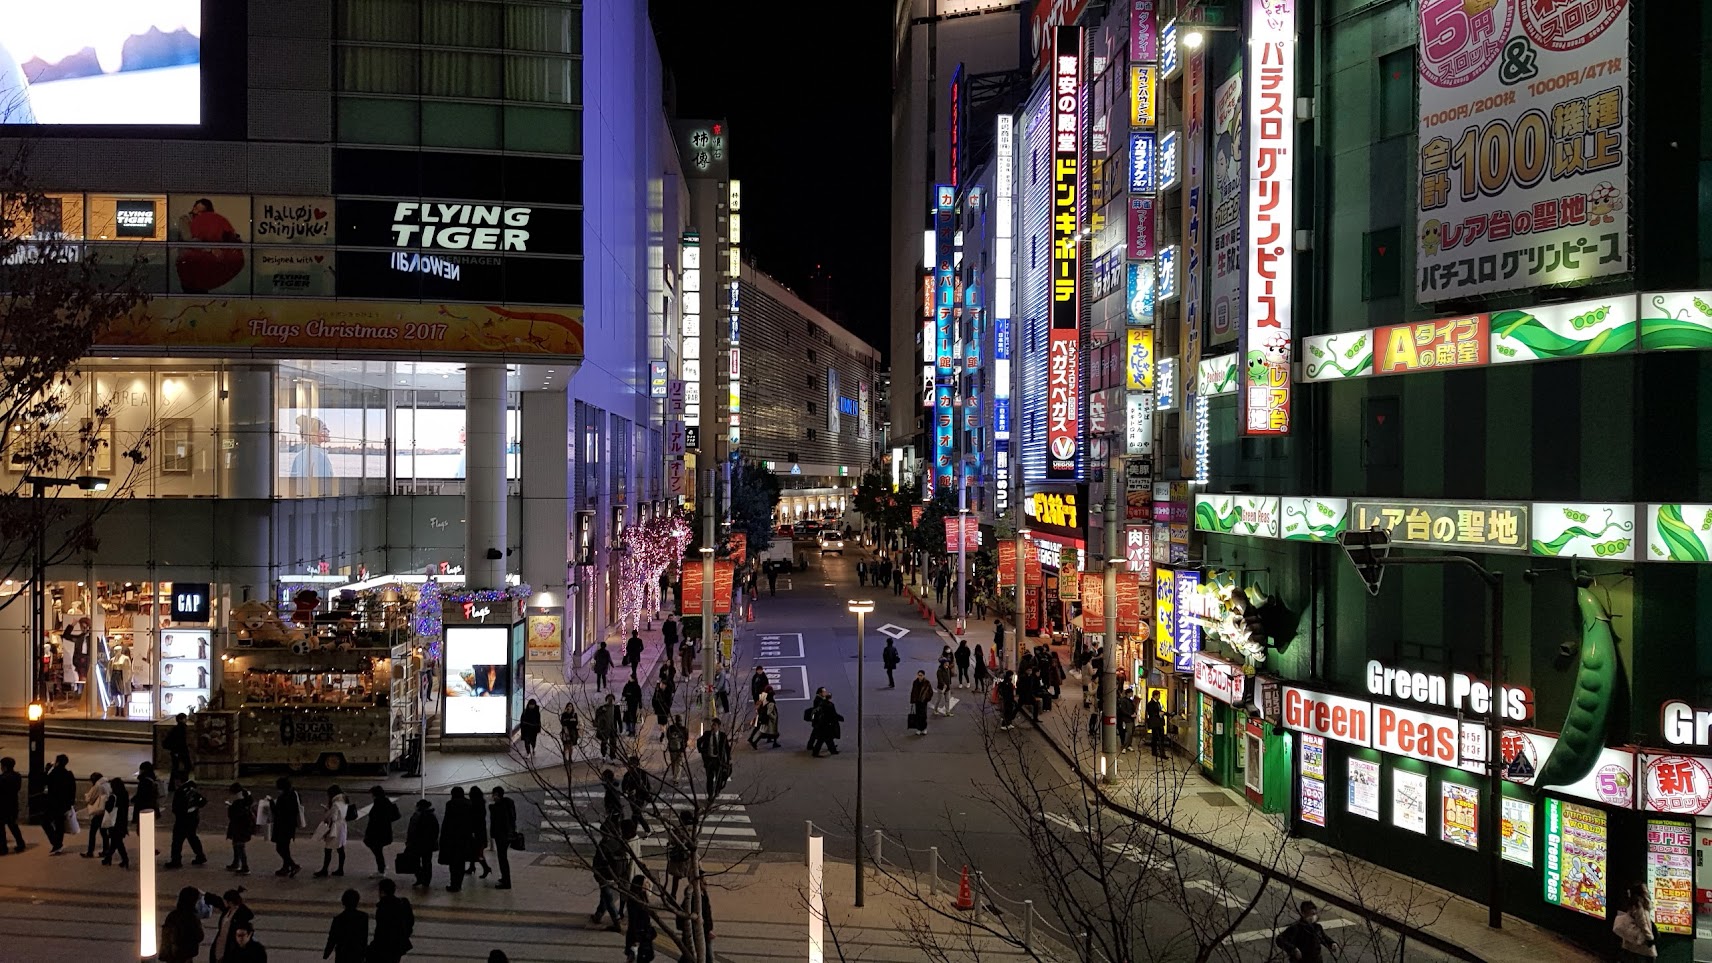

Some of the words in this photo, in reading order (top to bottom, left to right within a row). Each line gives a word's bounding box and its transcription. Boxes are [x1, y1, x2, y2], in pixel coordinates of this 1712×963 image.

[1438, 39, 1498, 79] スロット
[1499, 36, 1539, 86] &
[1528, 57, 1622, 98] 1000円/47枚
[1057, 55, 1077, 152] 驚安の殿堂
[1423, 90, 1517, 128] 1000円/200枚
[1552, 87, 1622, 139] 機種
[1134, 139, 1148, 180] カラオケ
[1450, 110, 1551, 200] 100
[1552, 131, 1622, 179] 以上
[1257, 41, 1287, 328] パチスログリンピース
[1422, 136, 1450, 209] 合計
[116, 210, 153, 218] FLYING
[116, 217, 154, 225] TIGER
[264, 204, 312, 222] Halløj
[393, 202, 532, 227] FLYING
[1441, 193, 1588, 250] レア台の聖地
[257, 220, 329, 240] Shinjuku!
[391, 224, 530, 251] TIGER
[1055, 159, 1077, 302] ドン・キホーテ
[296, 255, 314, 264] with
[272, 273, 311, 281] FLYING
[272, 280, 310, 288] TIGER
[249, 318, 300, 342] Flags
[305, 320, 398, 340] Christmas
[404, 323, 449, 341] 2017
[1133, 331, 1149, 341] 2F
[1382, 325, 1420, 371] A
[1415, 317, 1480, 347] タイプ
[1068, 340, 1077, 397] パチンコ・スロット
[1418, 341, 1479, 367] の殿堂
[113, 390, 170, 407] DREAS
[671, 382, 683, 410] リニュ
[1052, 340, 1068, 432] ベガスベガス
[671, 423, 682, 452] ーアル
[939, 395, 952, 487] カラオケ館
[671, 462, 682, 492] オープン
[1242, 509, 1256, 523] Green
[1257, 511, 1270, 524] Peas
[1358, 506, 1519, 545] レア台の聖地
[1128, 528, 1144, 572] 肉バル
[439, 561, 462, 577] Flags
[177, 593, 201, 612] GAP
[463, 601, 491, 624] Flags
[1366, 659, 1447, 707] Green
[296, 723, 334, 733] SUGAR
[296, 732, 335, 742] SHACK
[1285, 689, 1366, 742] Green
[1378, 707, 1455, 762] Peas
[1471, 732, 1481, 743] 5F
[1471, 745, 1481, 756] 3F
[1599, 773, 1629, 798] 5円
[1656, 760, 1696, 795] 新
[1655, 796, 1708, 812] スロット
[1548, 834, 1560, 869] Green
[1647, 831, 1692, 846] 専門店
[1547, 871, 1560, 902] Peas
